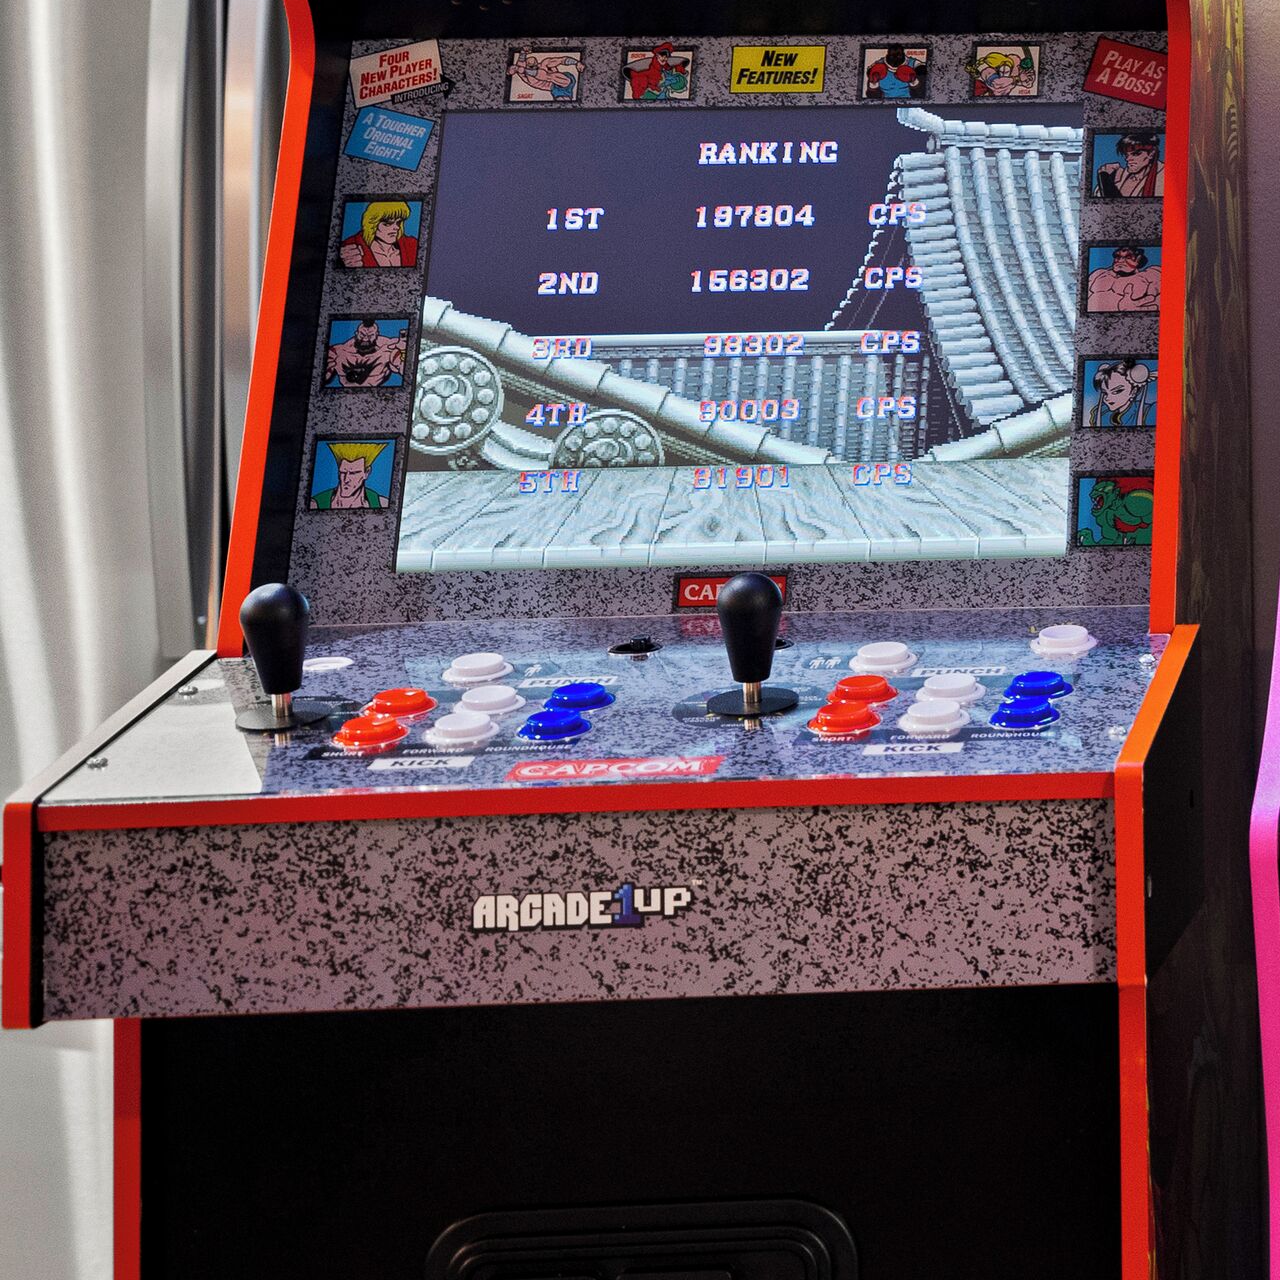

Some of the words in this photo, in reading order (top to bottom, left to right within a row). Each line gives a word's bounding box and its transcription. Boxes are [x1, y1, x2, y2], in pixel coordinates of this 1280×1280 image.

[379, 51, 410, 68] FOUR
[760, 50, 798, 67] NEW
[1102, 50, 1143, 73] PLAY
[1142, 60, 1166, 80] AS
[359, 67, 438, 100] CHARACTERS!
[360, 70, 387, 87] NEW
[389, 58, 433, 79] PLAYER
[736, 67, 818, 85] FEATURES!
[1095, 67, 1109, 84] A
[1112, 72, 1162, 97] BOSS!
[394, 82, 449, 103] INTRODUCING
[362, 113, 374, 125] A
[376, 115, 426, 138] TOUGHER
[363, 127, 414, 150] ORIGINAL
[364, 141, 405, 161] EIGHT!
[698, 141, 839, 165] RANKING
[546, 208, 605, 231] 1ST
[695, 204, 815, 228] 197804
[868, 202, 928, 226] CPS
[537, 271, 600, 295] 2ND
[690, 268, 810, 293] 156302
[863, 267, 924, 291] CPS
[531, 337, 594, 361] 3RD
[859, 330, 922, 354] CPS
[524, 401, 588, 426] 4TH
[856, 396, 917, 420] CPS
[518, 470, 582, 494] 5TH
[693, 465, 792, 491] 81901
[852, 462, 913, 486] CPS
[970, 731, 1056, 739] ROUNDHOUSE
[402, 747, 465, 755] FORWARD
[484, 743, 573, 753] ROUNDHOUSE
[883, 744, 942, 753] KICK
[389, 758, 453, 768] KICK
[518, 758, 703, 778] CAPCOM
[472, 882, 692, 932] ARCADE1UP
